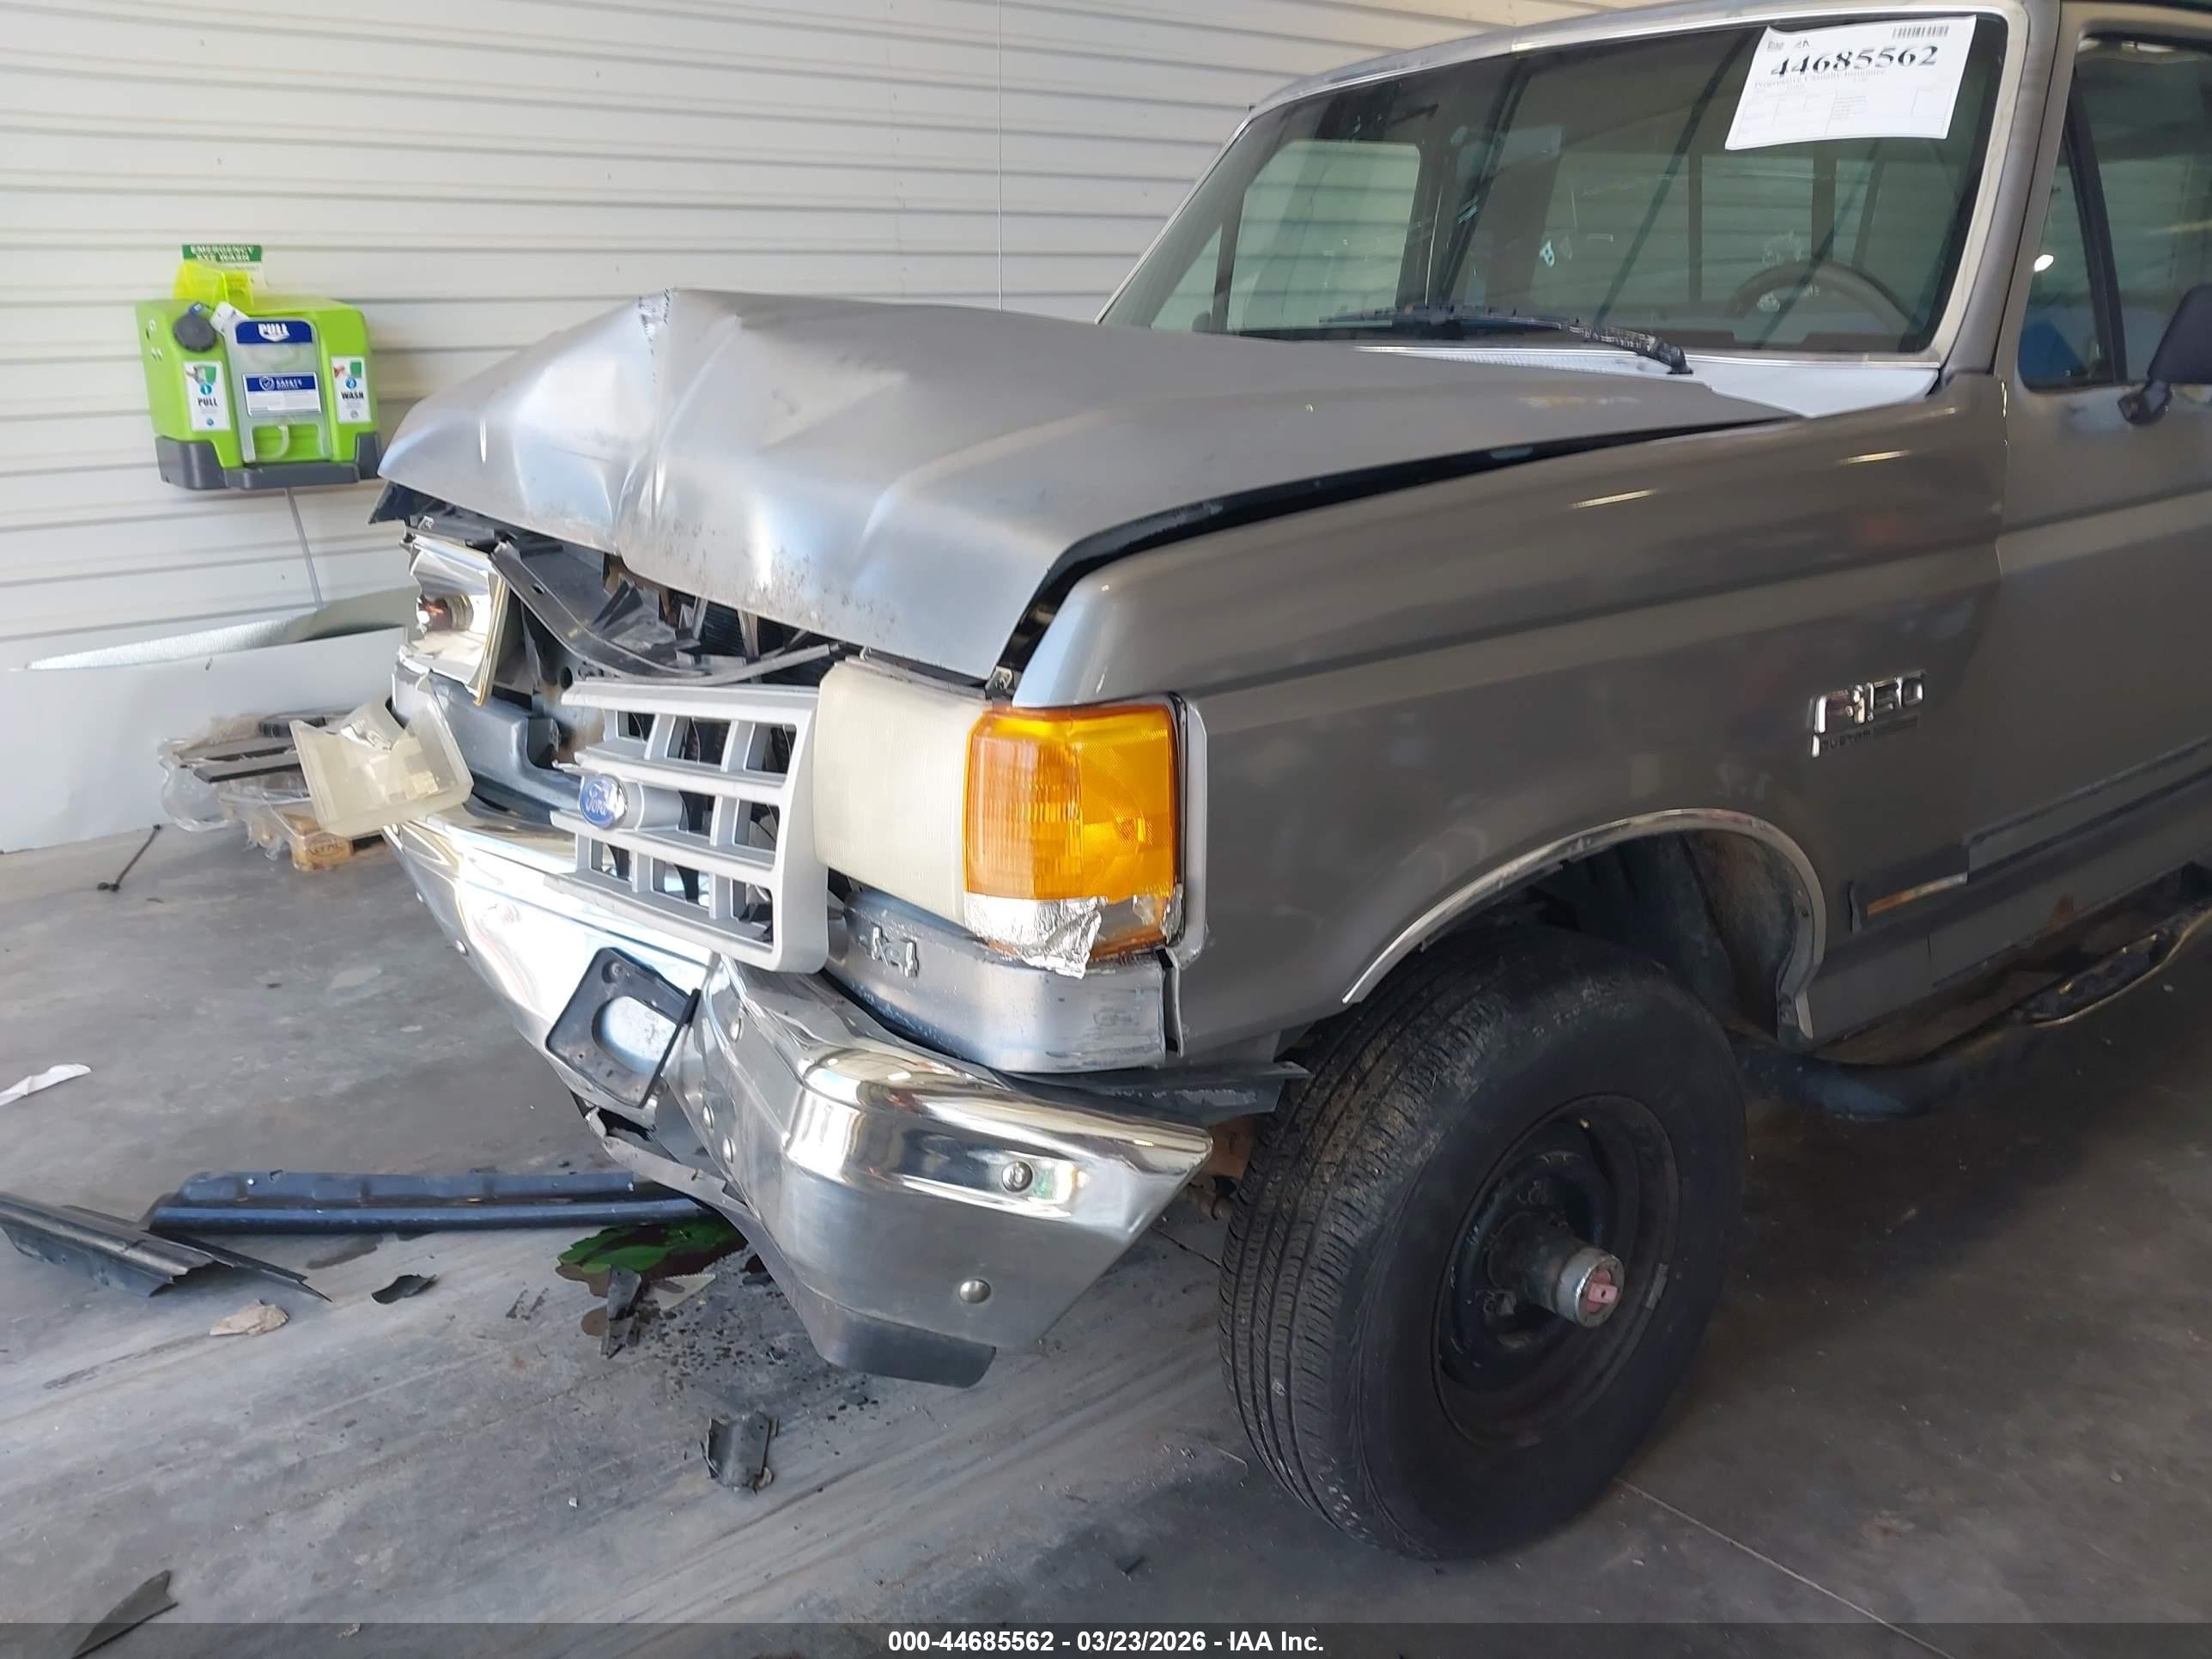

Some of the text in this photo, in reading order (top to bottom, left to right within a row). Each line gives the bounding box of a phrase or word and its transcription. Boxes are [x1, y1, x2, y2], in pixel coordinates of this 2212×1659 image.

[1771, 46, 1938, 76] 44685562
[258, 324, 289, 340] PULL
[341, 391, 365, 400] WASH
[198, 398, 218, 406] PULL
